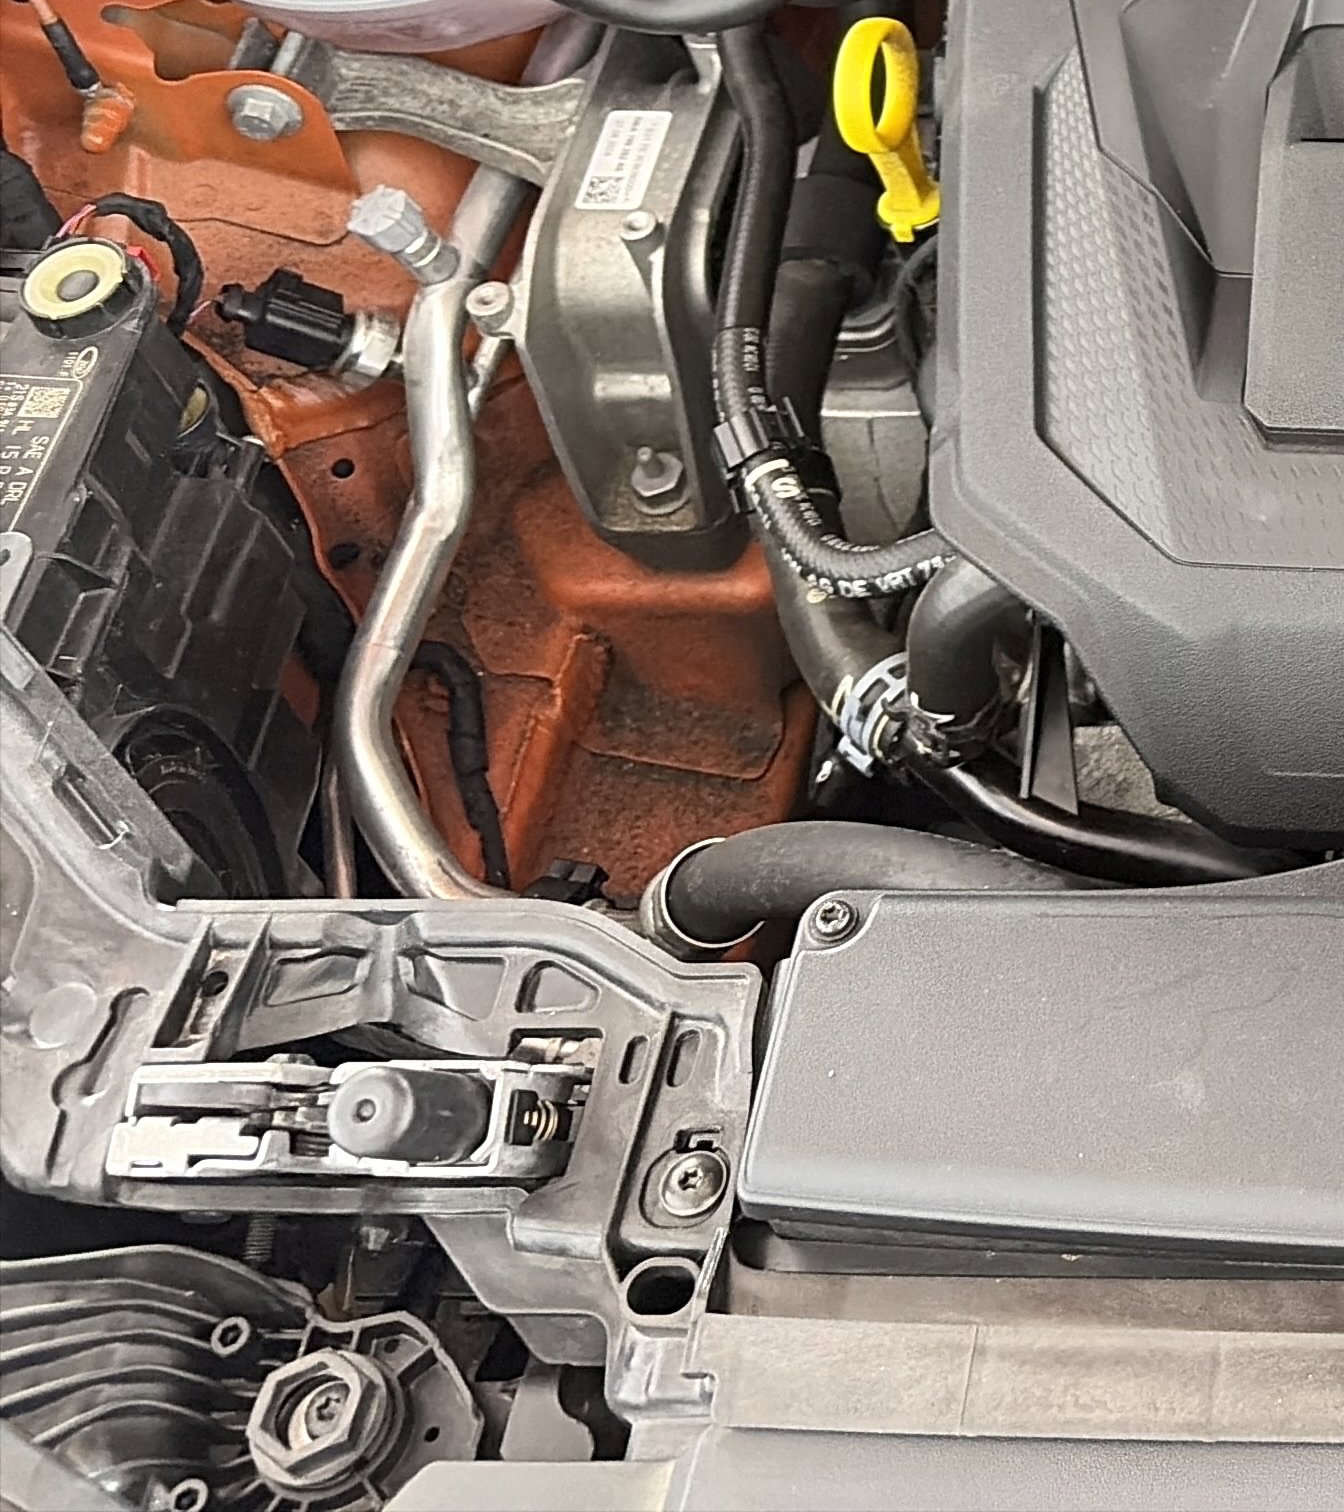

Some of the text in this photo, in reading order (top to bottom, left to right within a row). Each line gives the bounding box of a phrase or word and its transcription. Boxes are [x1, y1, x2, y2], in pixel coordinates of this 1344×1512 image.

[0, 435, 50, 506] SAE A DRL
